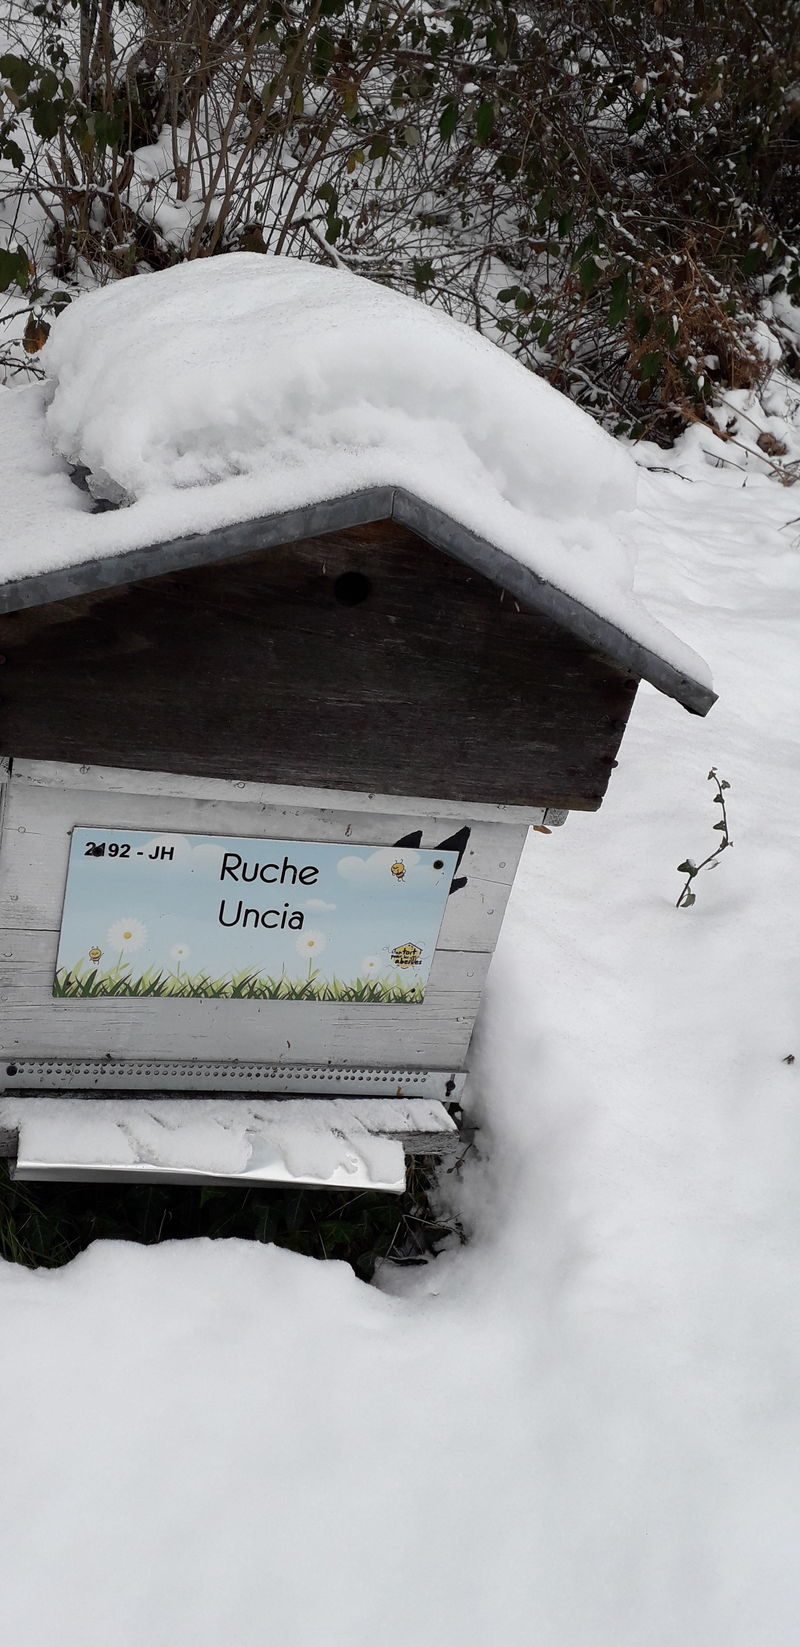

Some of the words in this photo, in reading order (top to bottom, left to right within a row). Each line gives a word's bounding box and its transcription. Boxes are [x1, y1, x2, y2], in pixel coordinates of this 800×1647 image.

[84, 842, 131, 858] 2192
[148, 846, 175, 861] JH
[219, 852, 320, 886] Ruche
[218, 899, 305, 930] Uncia
